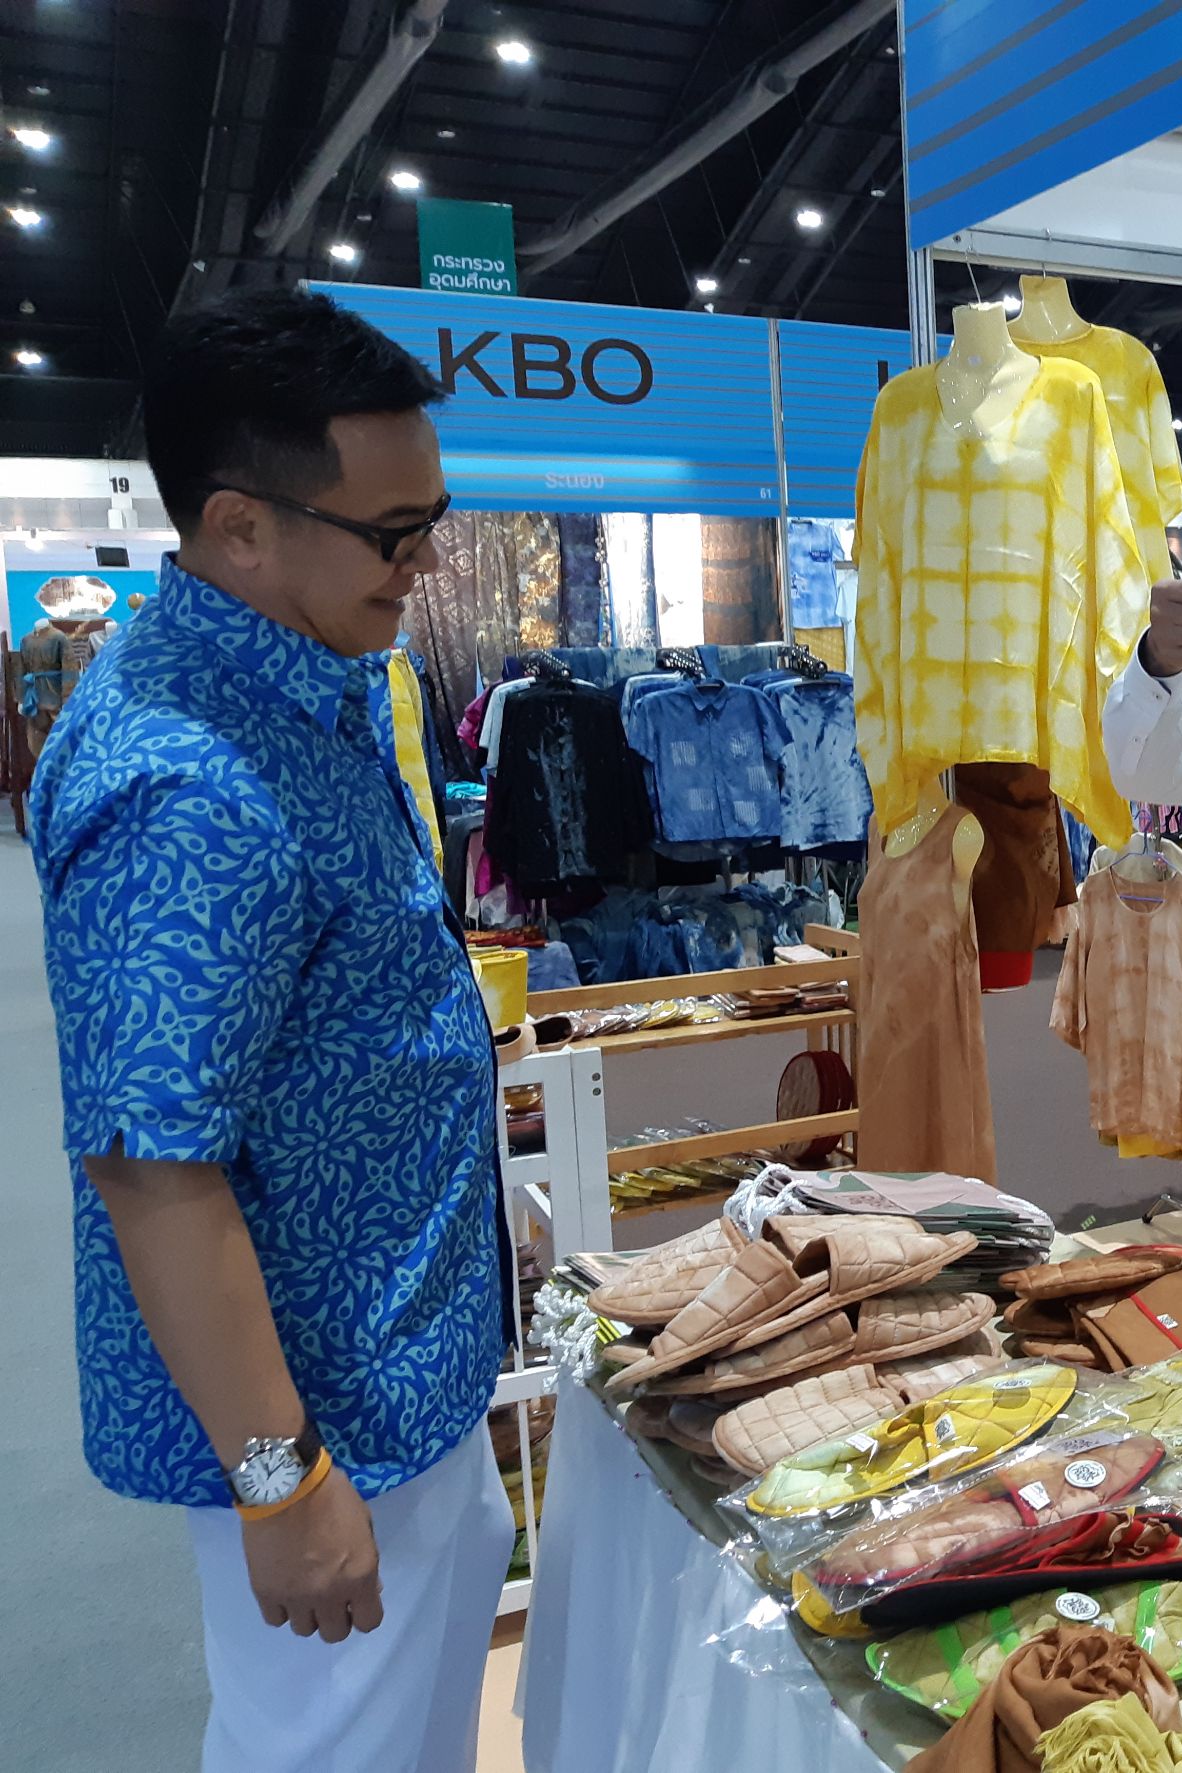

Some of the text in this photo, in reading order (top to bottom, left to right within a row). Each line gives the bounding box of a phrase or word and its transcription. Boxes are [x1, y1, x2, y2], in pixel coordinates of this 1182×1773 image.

[433, 254, 505, 273] กระทรวง
[429, 271, 511, 291] อุดมศึกษา
[438, 327, 654, 405] KBO
[109, 477, 130, 494] 19
[545, 471, 605, 489] ระนอง
